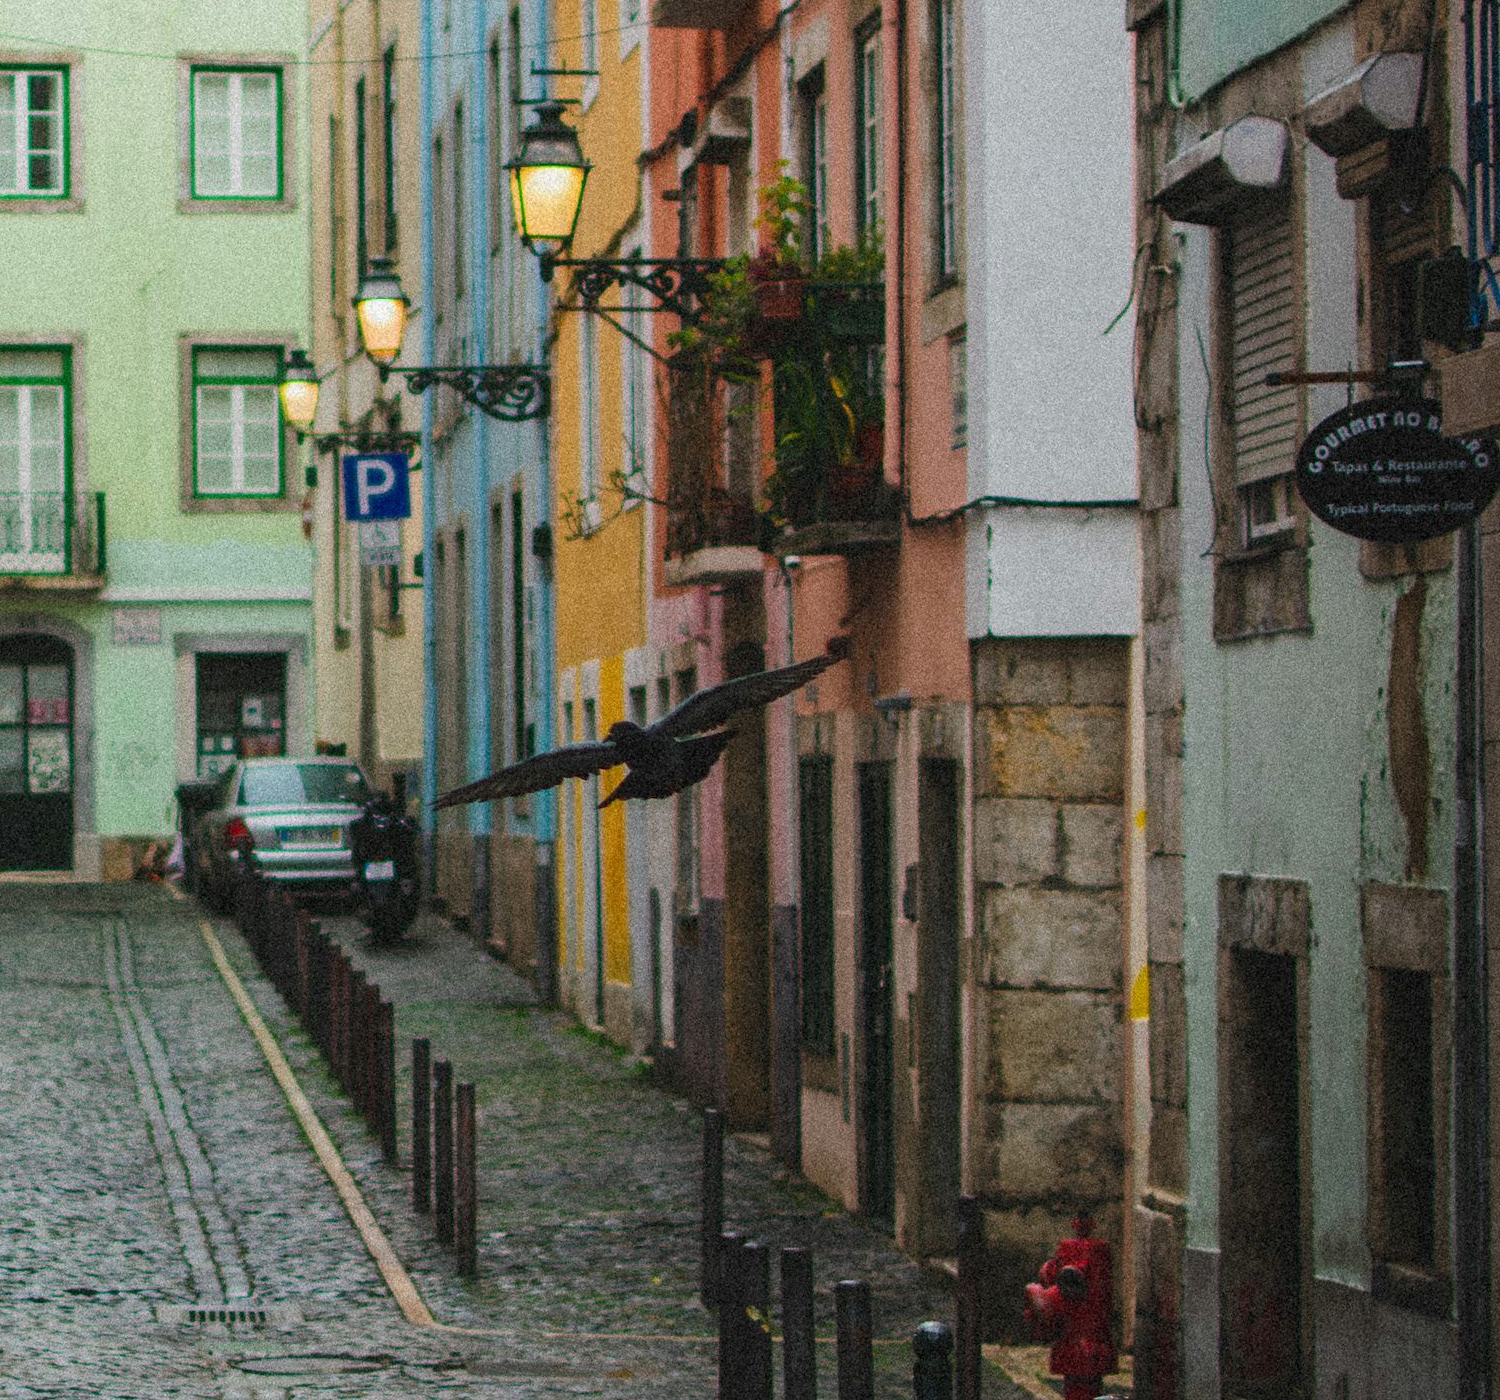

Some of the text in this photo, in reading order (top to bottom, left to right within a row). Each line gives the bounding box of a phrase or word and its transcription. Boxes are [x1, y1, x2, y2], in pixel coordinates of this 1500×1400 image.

[1307, 412, 1387, 473] GOURMET
[1332, 459, 1468, 474] Tapas & Restaurante
[357, 459, 395, 515] P
[1327, 500, 1475, 517] Typical Portuguese Food
